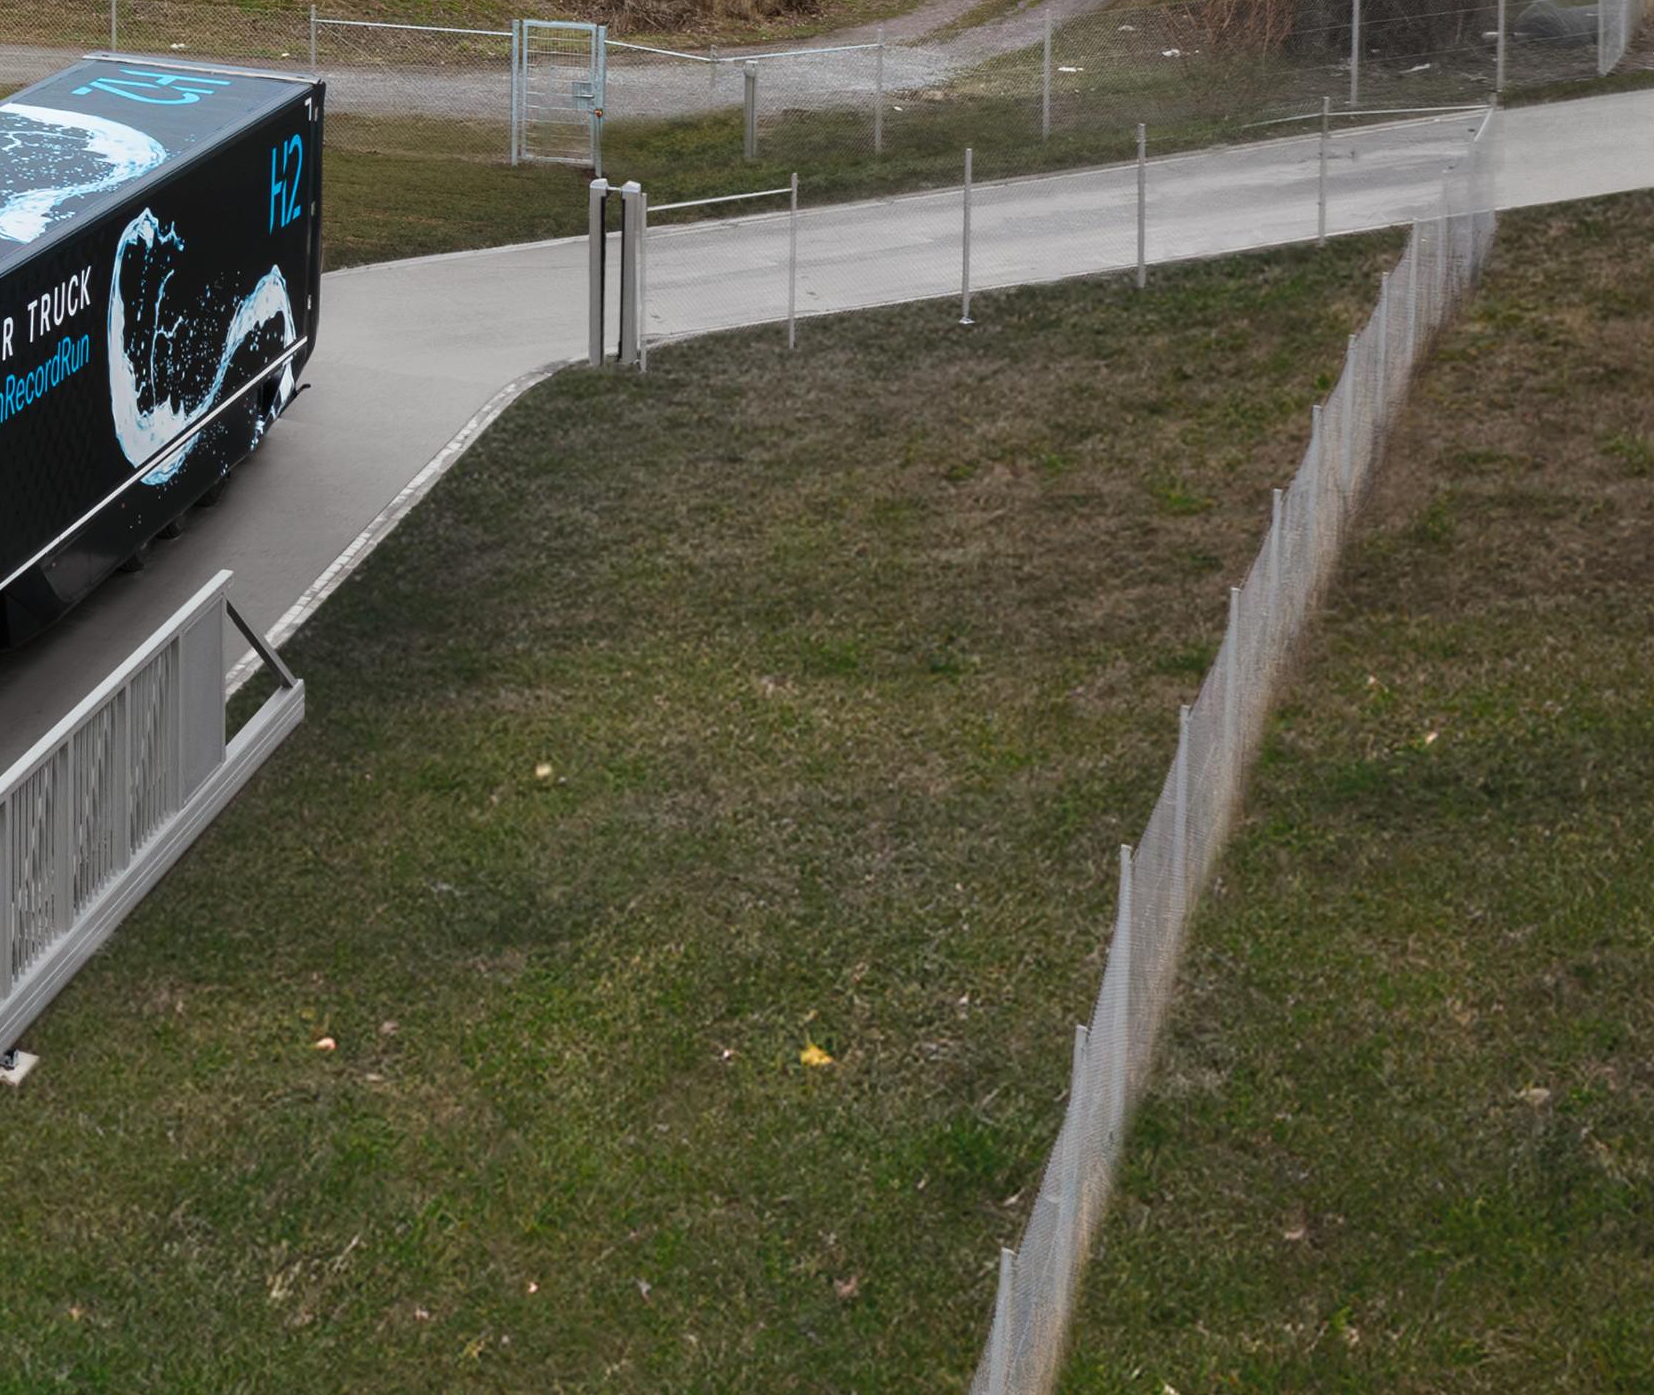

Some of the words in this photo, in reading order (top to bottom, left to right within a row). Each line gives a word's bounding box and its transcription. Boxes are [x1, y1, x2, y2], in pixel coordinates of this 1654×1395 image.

[71, 68, 233, 105] H2
[269, 133, 304, 237] H2
[27, 265, 92, 343] TRUCK
